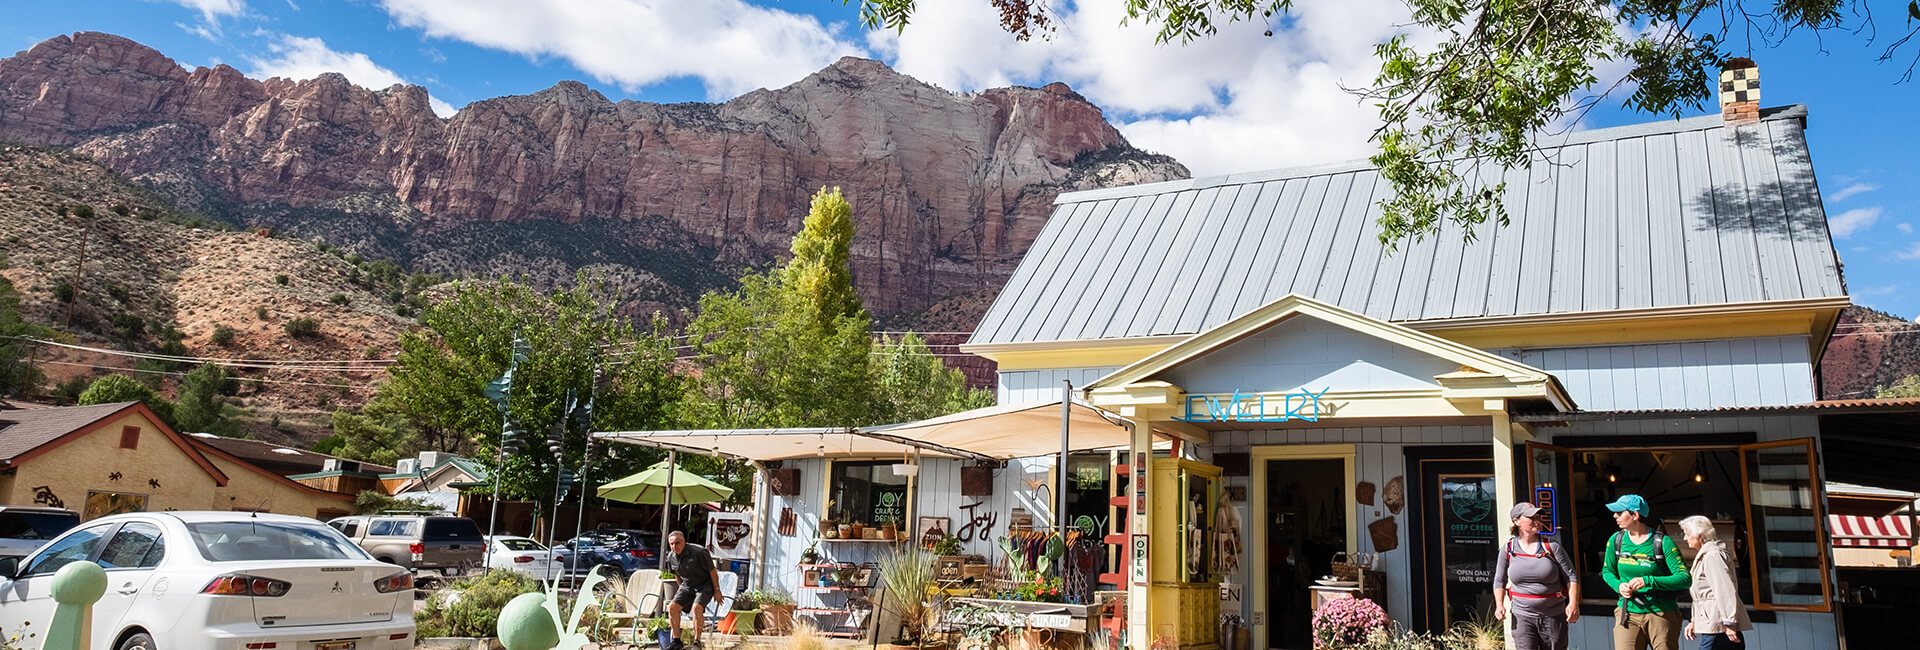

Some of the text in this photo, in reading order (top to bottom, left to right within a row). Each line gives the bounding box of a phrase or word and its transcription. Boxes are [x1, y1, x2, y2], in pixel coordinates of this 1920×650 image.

[1171, 387, 1329, 422] JEWELRY
[875, 492, 904, 507] JOY
[957, 501, 998, 542] Joy
[924, 533, 942, 541] ZION
[941, 567, 958, 575] open
[1136, 540, 1145, 577] OPEN
